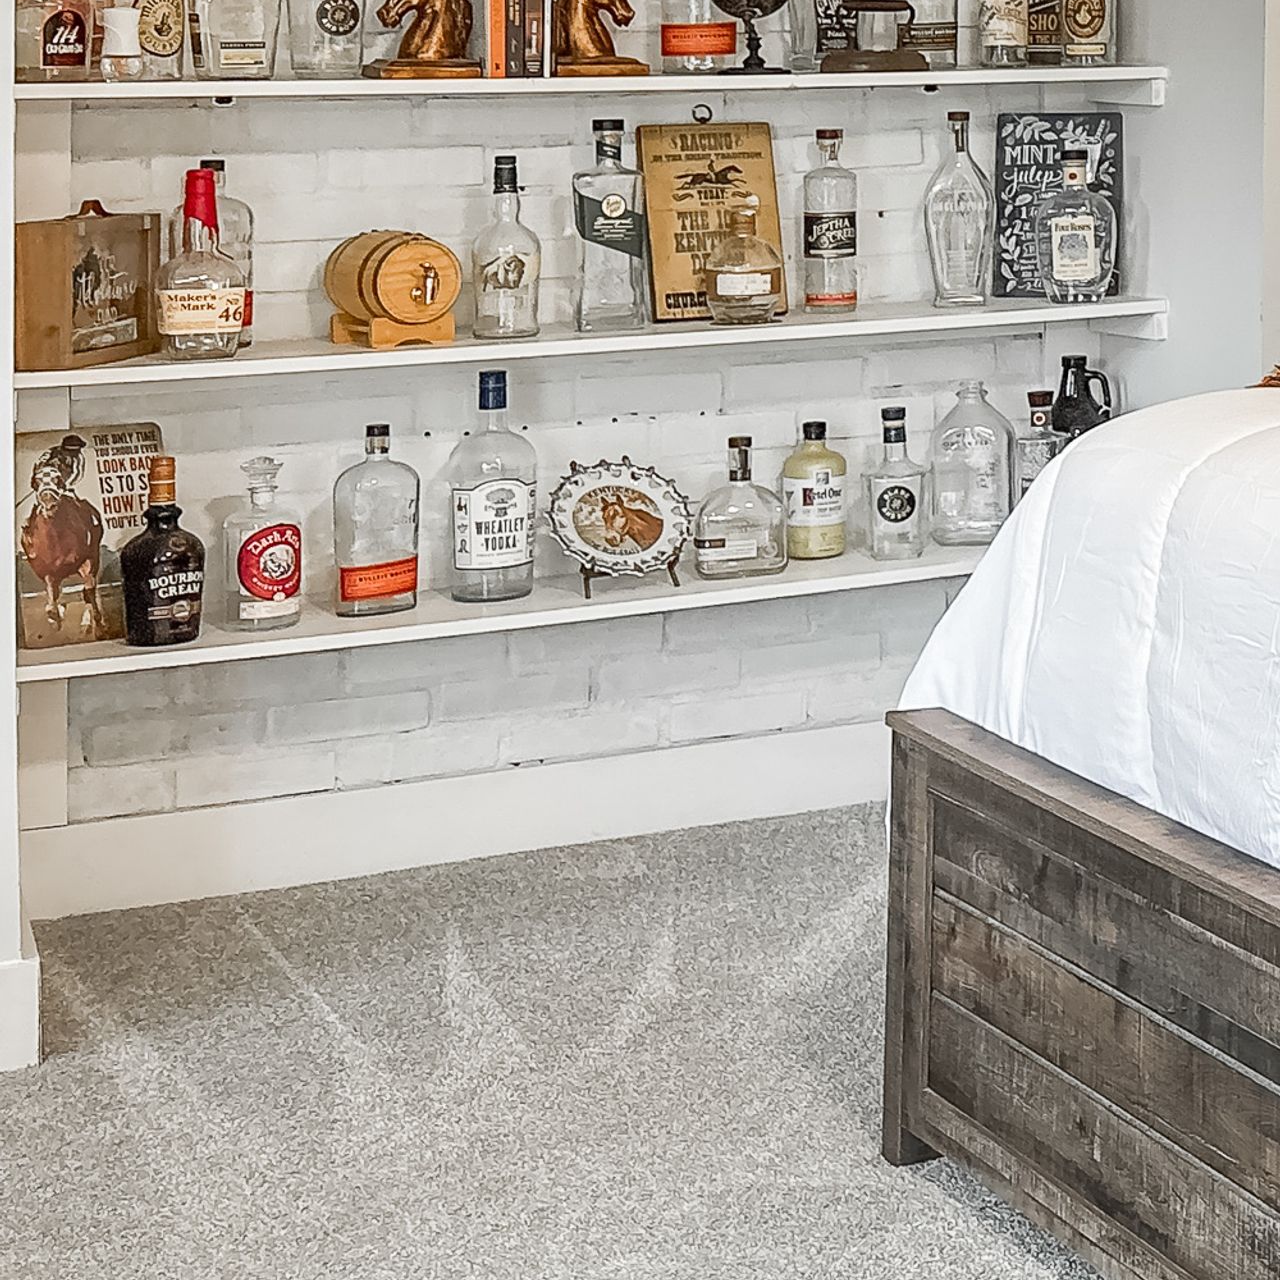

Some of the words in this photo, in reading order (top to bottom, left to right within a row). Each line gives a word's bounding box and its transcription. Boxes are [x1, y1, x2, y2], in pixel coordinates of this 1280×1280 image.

[1003, 144, 1057, 166] MINT
[676, 210, 709, 232] THE
[167, 294, 218, 303] Maker's
[180, 303, 218, 312] Mark
[217, 305, 243, 323] 46
[92, 434, 110, 447] THE
[111, 432, 134, 445] ONLY
[96, 458, 128, 475] LOOK
[129, 455, 153, 472] BAC
[99, 476, 115, 495] IS
[116, 474, 136, 493] TO
[102, 494, 134, 515] HOW
[105, 514, 139, 530] YOU'VE
[474, 516, 525, 536] WHEATLEY
[483, 534, 517, 552] VODKA
